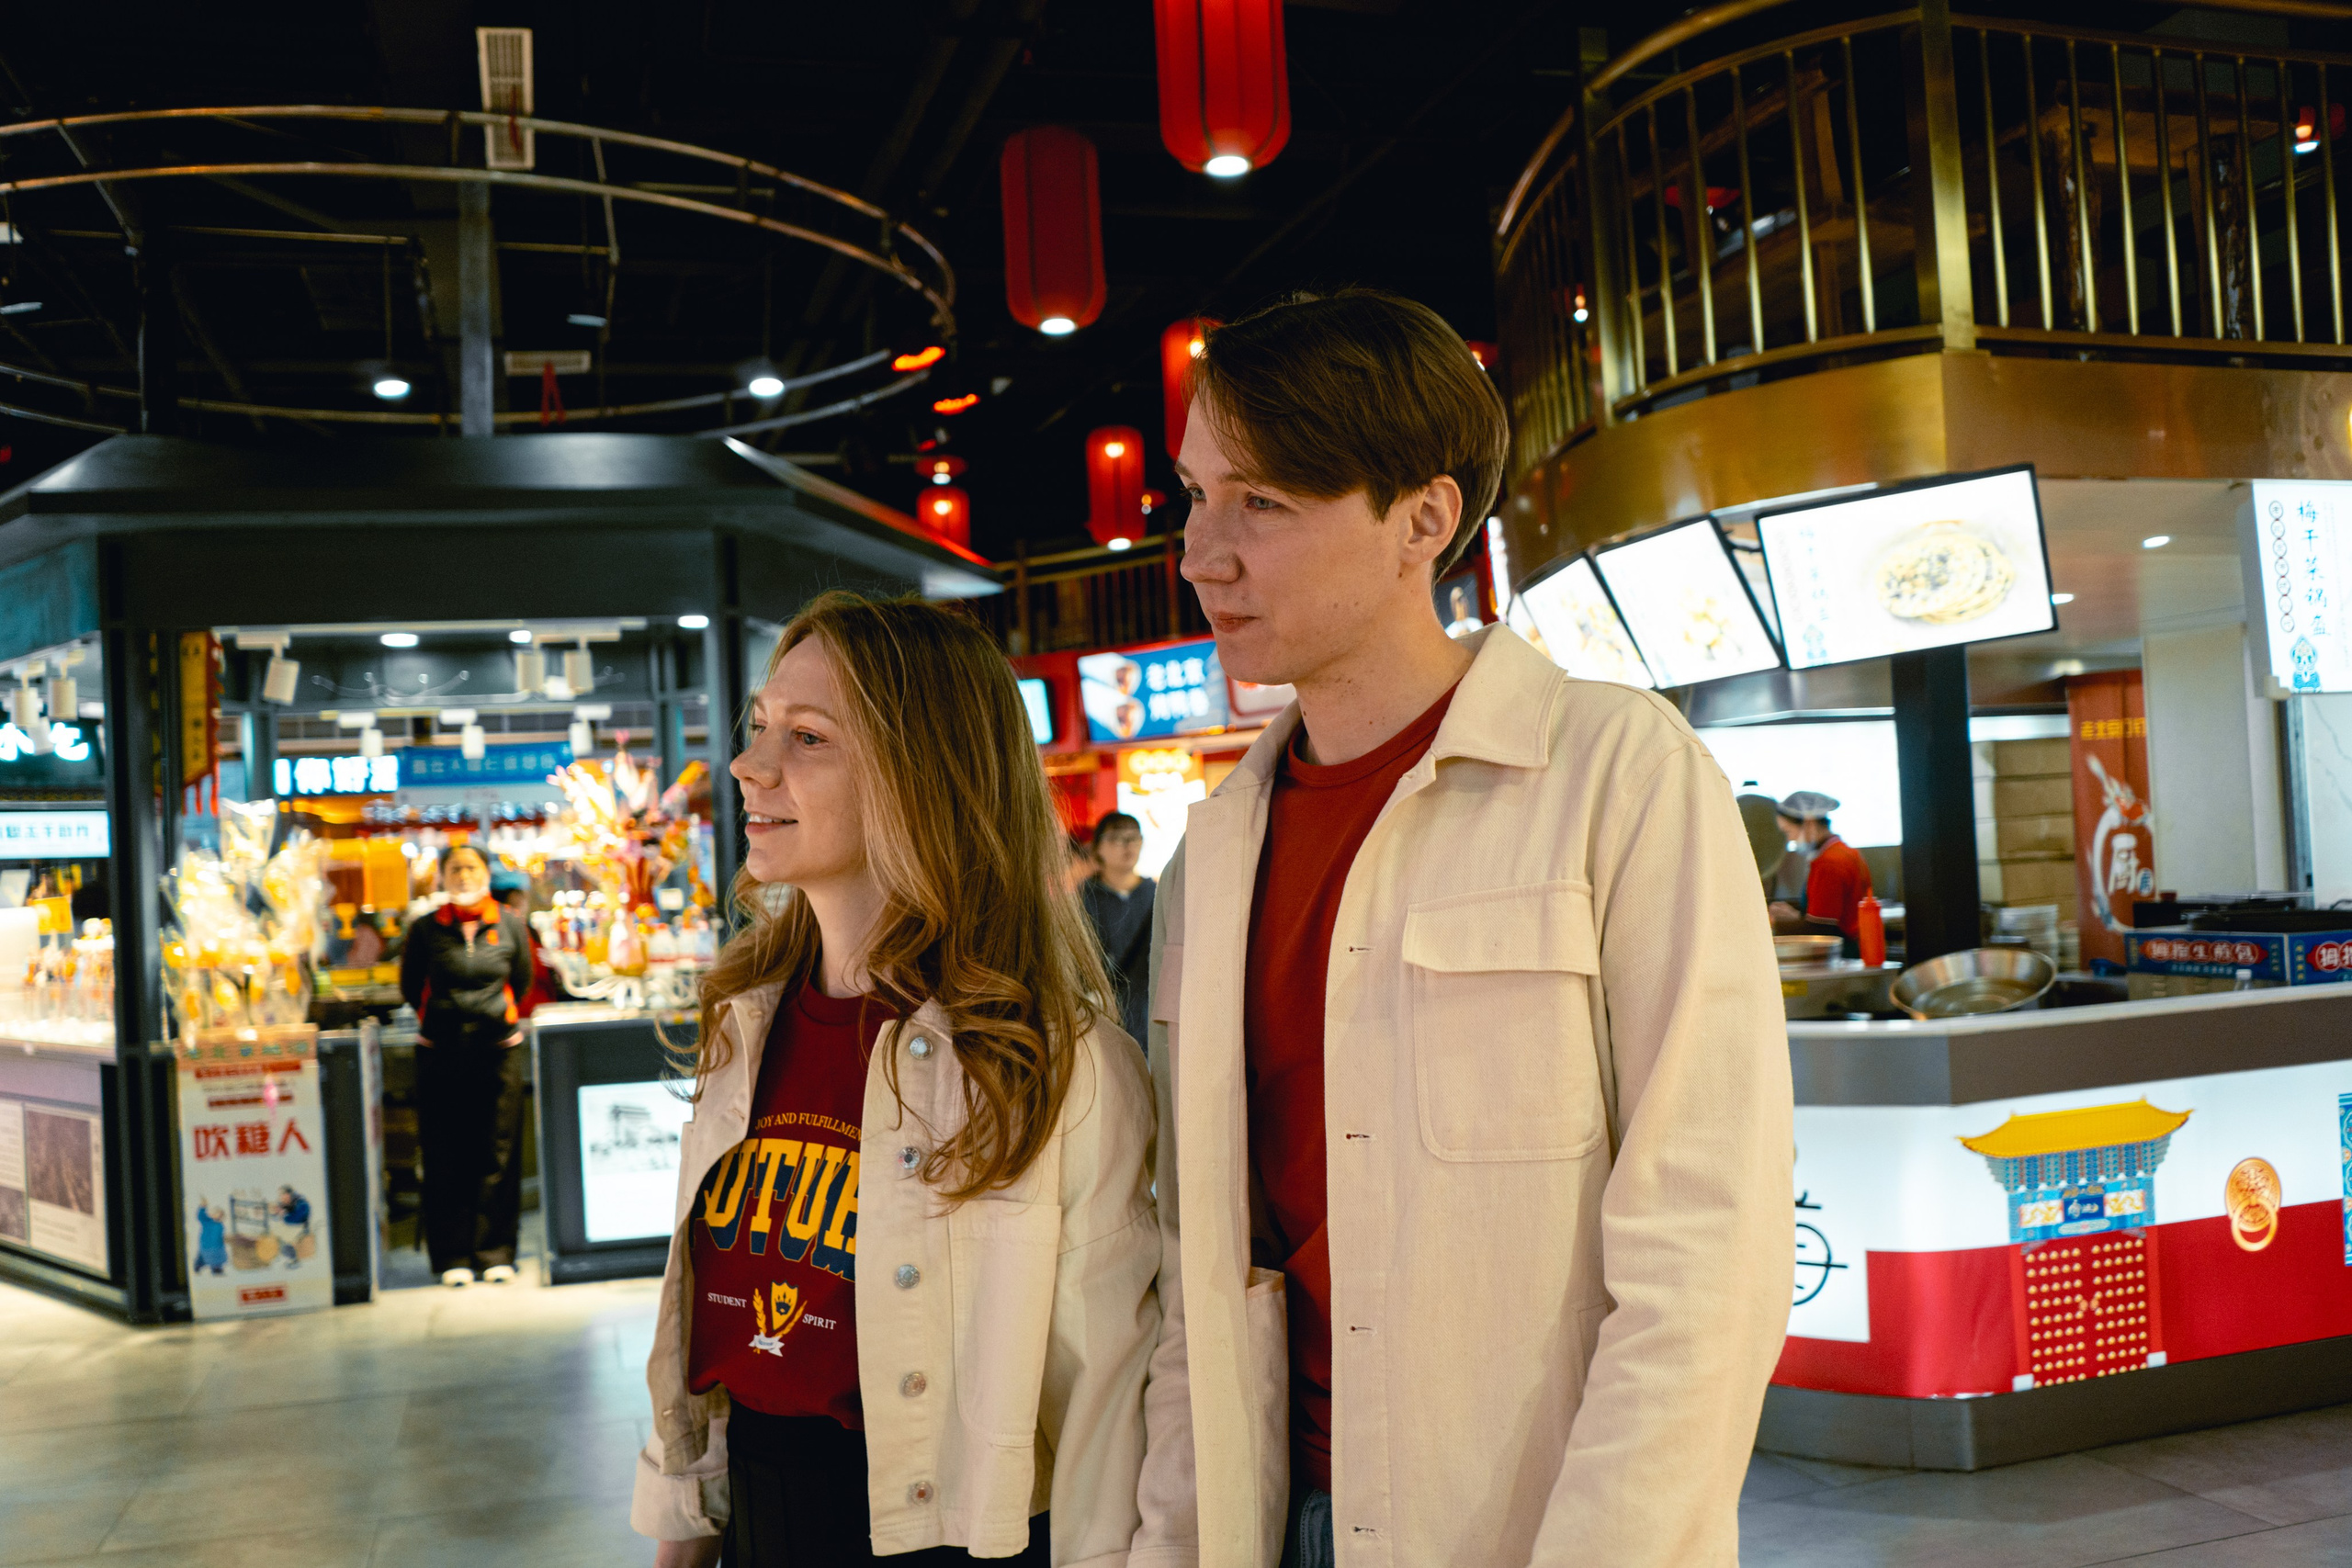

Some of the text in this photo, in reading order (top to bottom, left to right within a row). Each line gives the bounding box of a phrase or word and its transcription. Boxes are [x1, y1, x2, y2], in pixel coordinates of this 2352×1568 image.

[754, 1114, 775, 1131] JOY
[775, 1112, 797, 1126] AND
[193, 1118, 311, 1160] 吹糖人
[707, 1292, 748, 1309] STUDENT
[801, 1313, 837, 1330] SPIRIT
